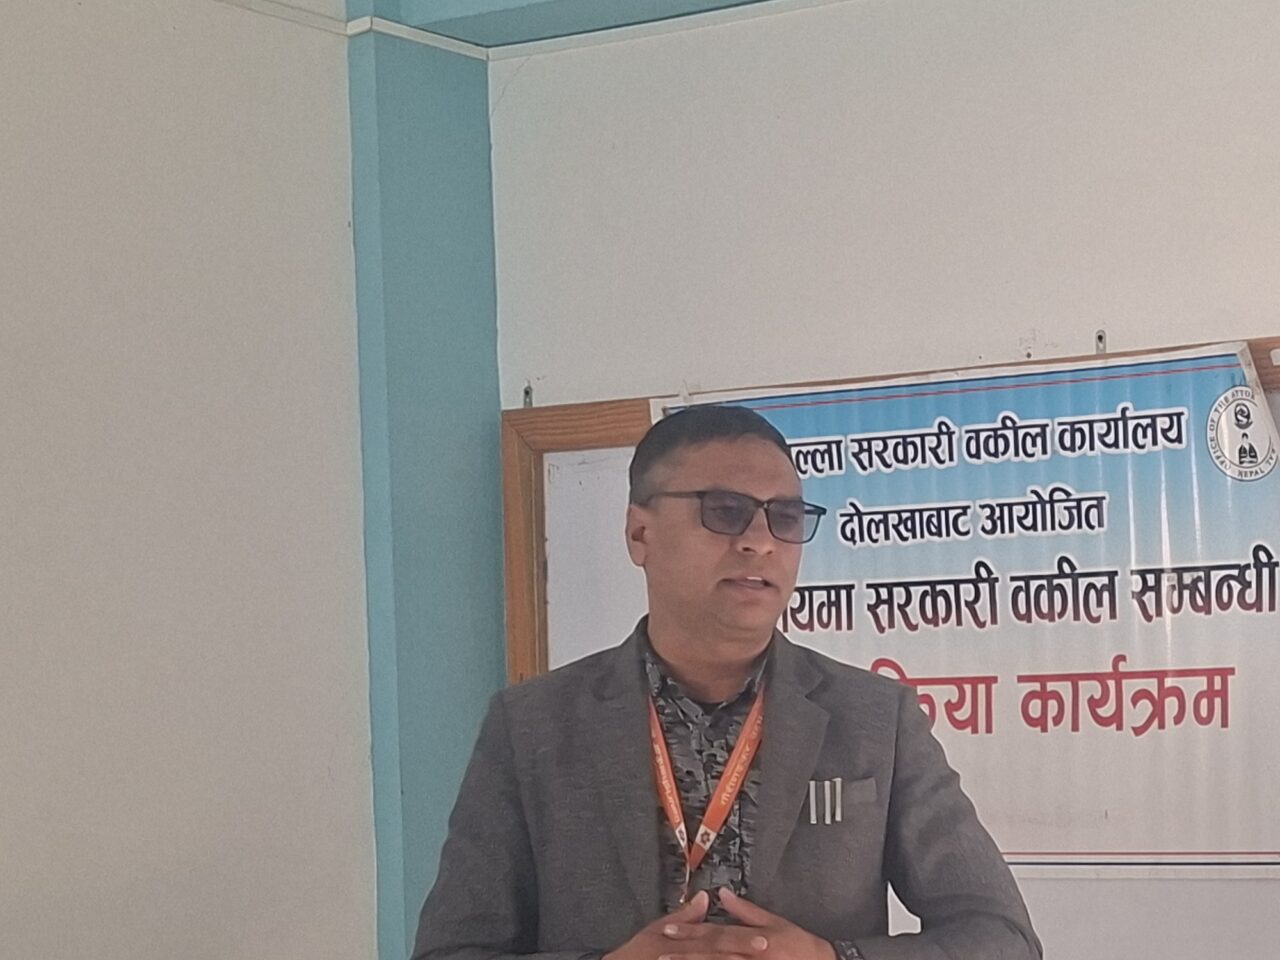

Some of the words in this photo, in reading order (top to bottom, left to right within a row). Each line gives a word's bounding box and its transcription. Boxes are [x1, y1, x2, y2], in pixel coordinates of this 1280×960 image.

[788, 440, 843, 475] ल्ला
[851, 421, 956, 471] सरकारी
[965, 415, 1050, 460] वकील
[1058, 407, 1185, 452] कार्यालय
[1237, 466, 1265, 478] NEPAL
[839, 502, 972, 546] दोलखाबाट
[979, 487, 1106, 535] आयोजित
[782, 584, 855, 633] यमा
[866, 560, 999, 634] सरकारी
[1010, 556, 1118, 624] वकील
[1131, 544, 1279, 623] सम्बन्धी
[1017, 654, 1236, 737] कार्यक्रम
